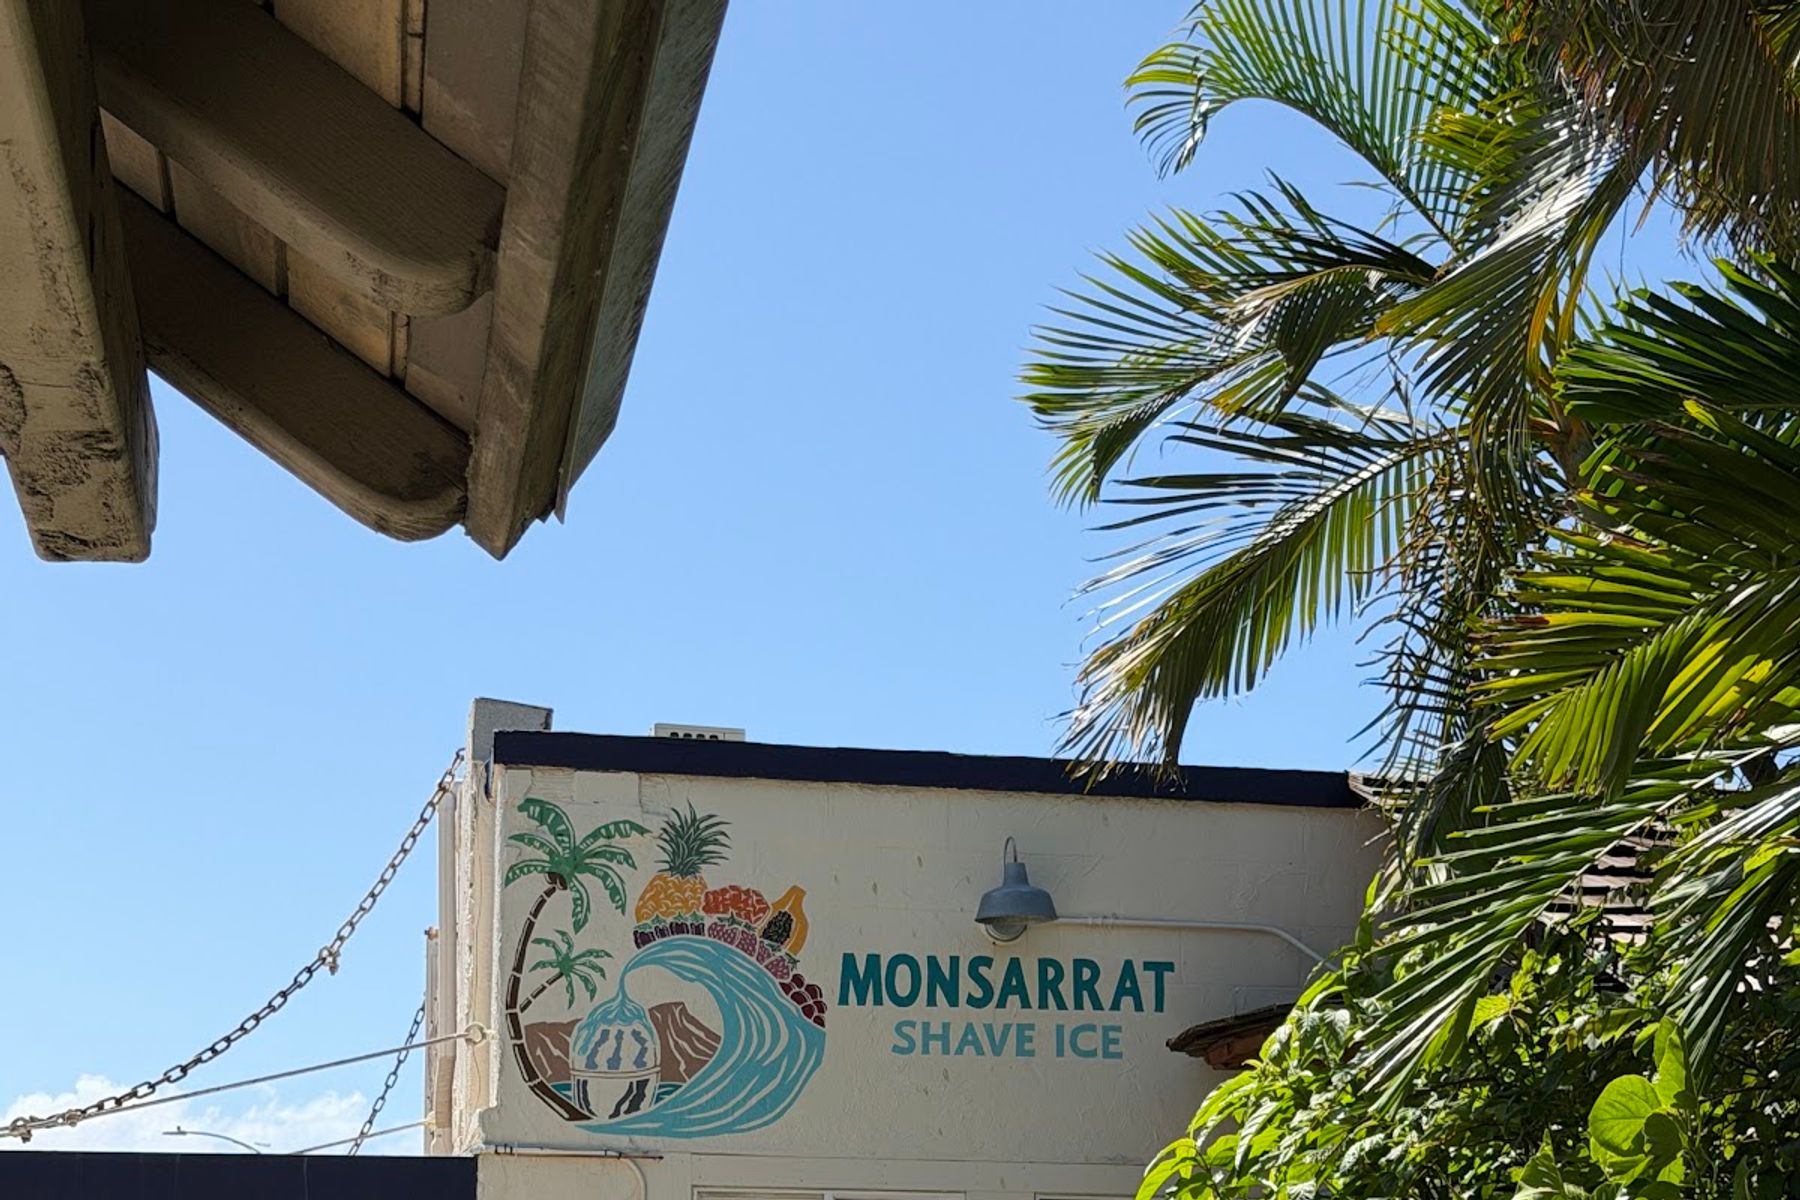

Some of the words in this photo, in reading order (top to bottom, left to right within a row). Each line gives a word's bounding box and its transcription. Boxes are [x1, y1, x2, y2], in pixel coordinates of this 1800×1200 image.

[838, 952, 1176, 1013] MONSARRAT
[891, 1020, 1036, 1057] SHAVE
[1056, 1023, 1124, 1060] ICE
